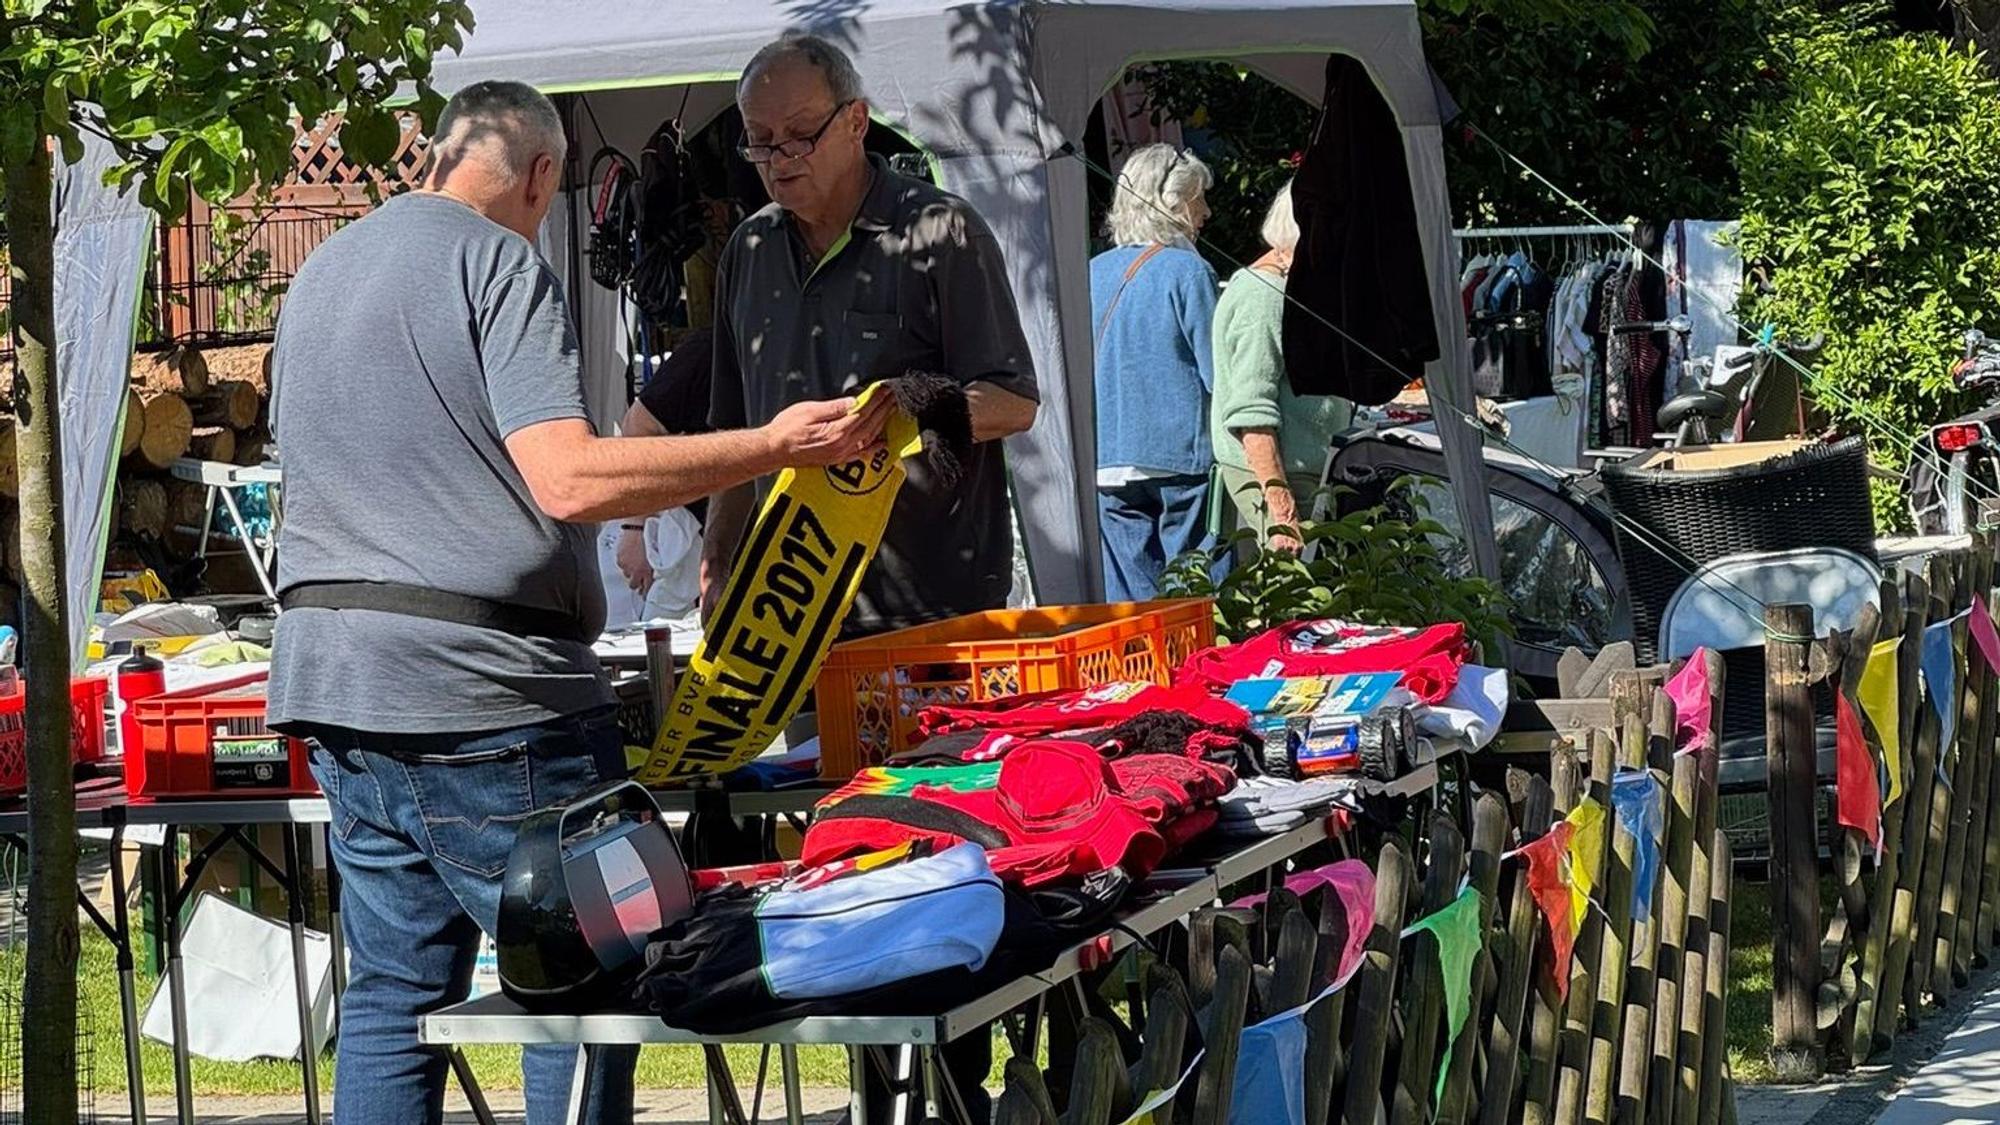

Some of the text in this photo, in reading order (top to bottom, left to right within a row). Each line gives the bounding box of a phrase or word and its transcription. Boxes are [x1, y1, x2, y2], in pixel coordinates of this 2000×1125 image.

[870, 447, 890, 473] 09
[668, 502, 836, 778] FINALE 2017
[677, 671, 707, 716] BVB
